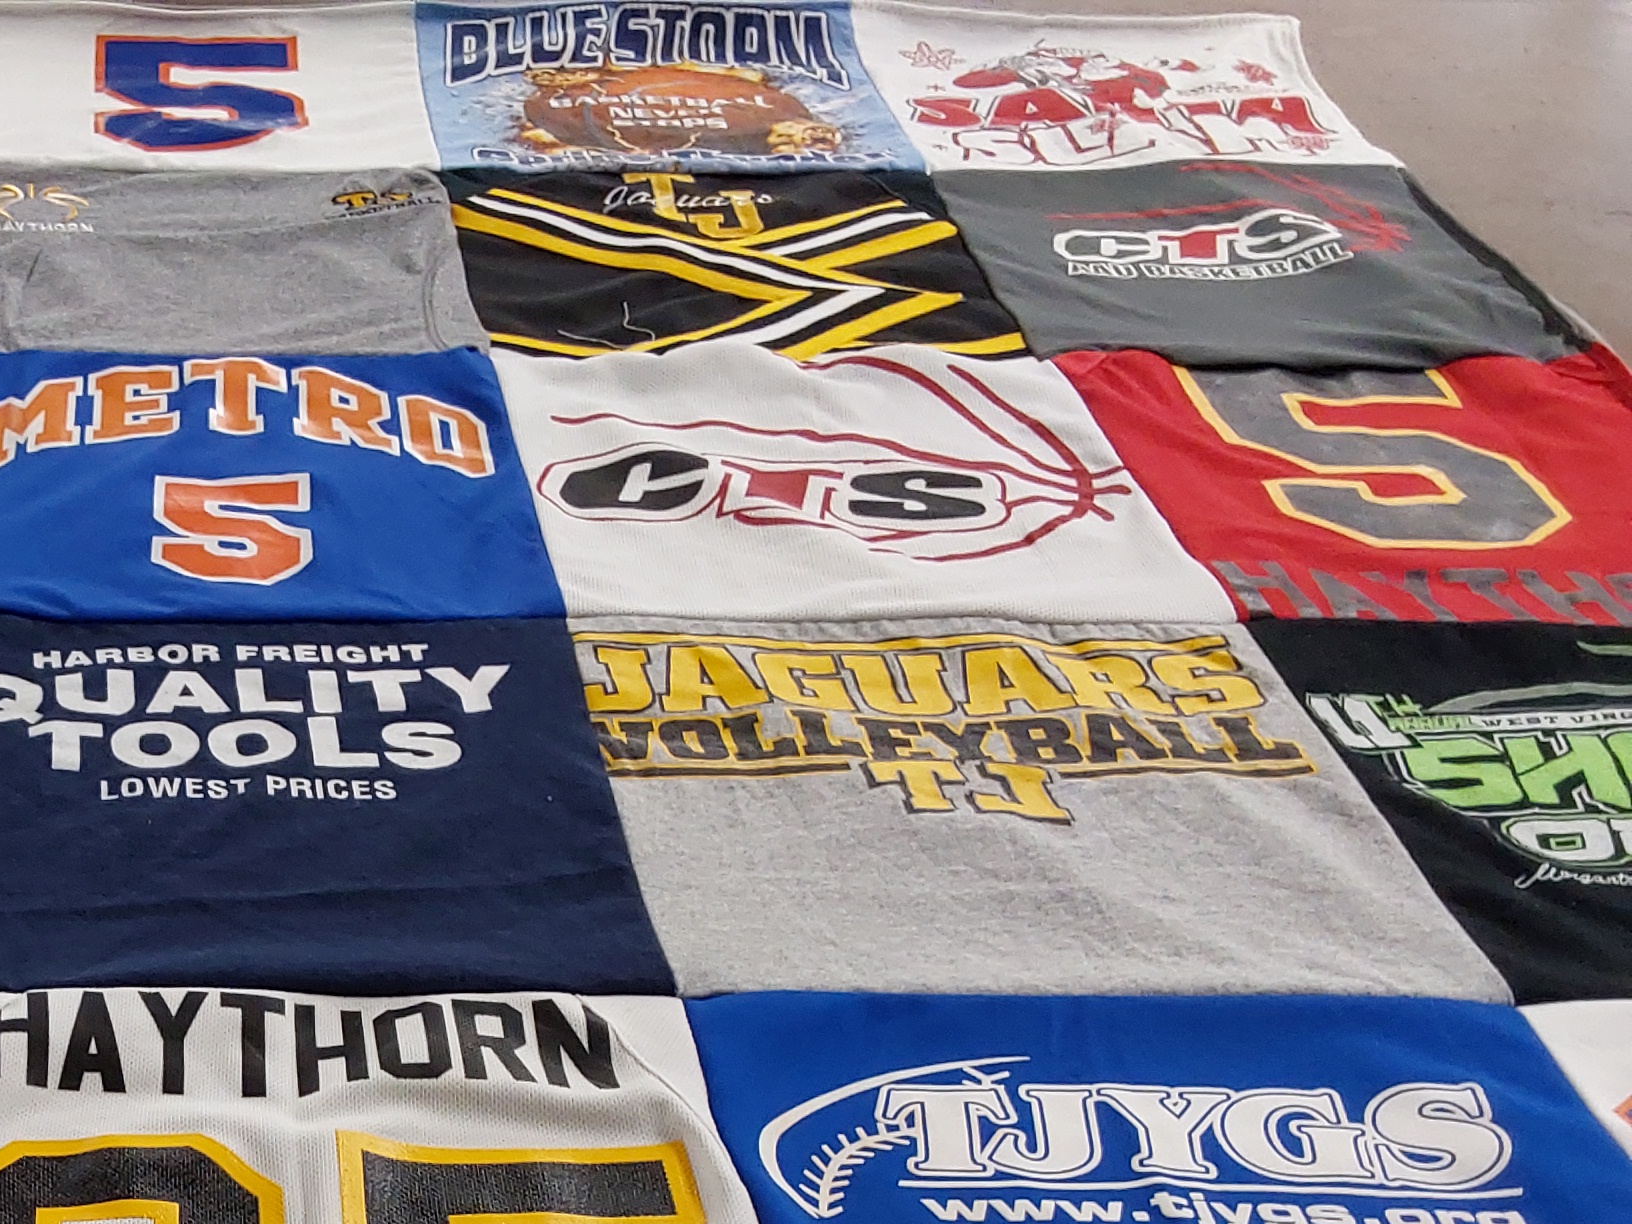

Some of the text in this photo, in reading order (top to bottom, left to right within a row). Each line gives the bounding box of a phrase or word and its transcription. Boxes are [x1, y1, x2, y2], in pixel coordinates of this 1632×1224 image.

[94, 35, 309, 152] 5
[1053, 208, 1343, 264] CTS
[1139, 240, 1354, 282] BASKETBALL
[1171, 365, 1573, 551] 5
[151, 472, 313, 586] 5
[31, 642, 430, 670] HARBOR FREIGHT
[584, 643, 1266, 717] JAGUARS
[27, 715, 463, 773] TOOLS
[589, 709, 1308, 768] VOLLEYBALL
[99, 774, 398, 802] LOWEST PRICES
[862, 758, 1076, 825] TJ
[875, 1082, 1513, 1191] TJYGS
